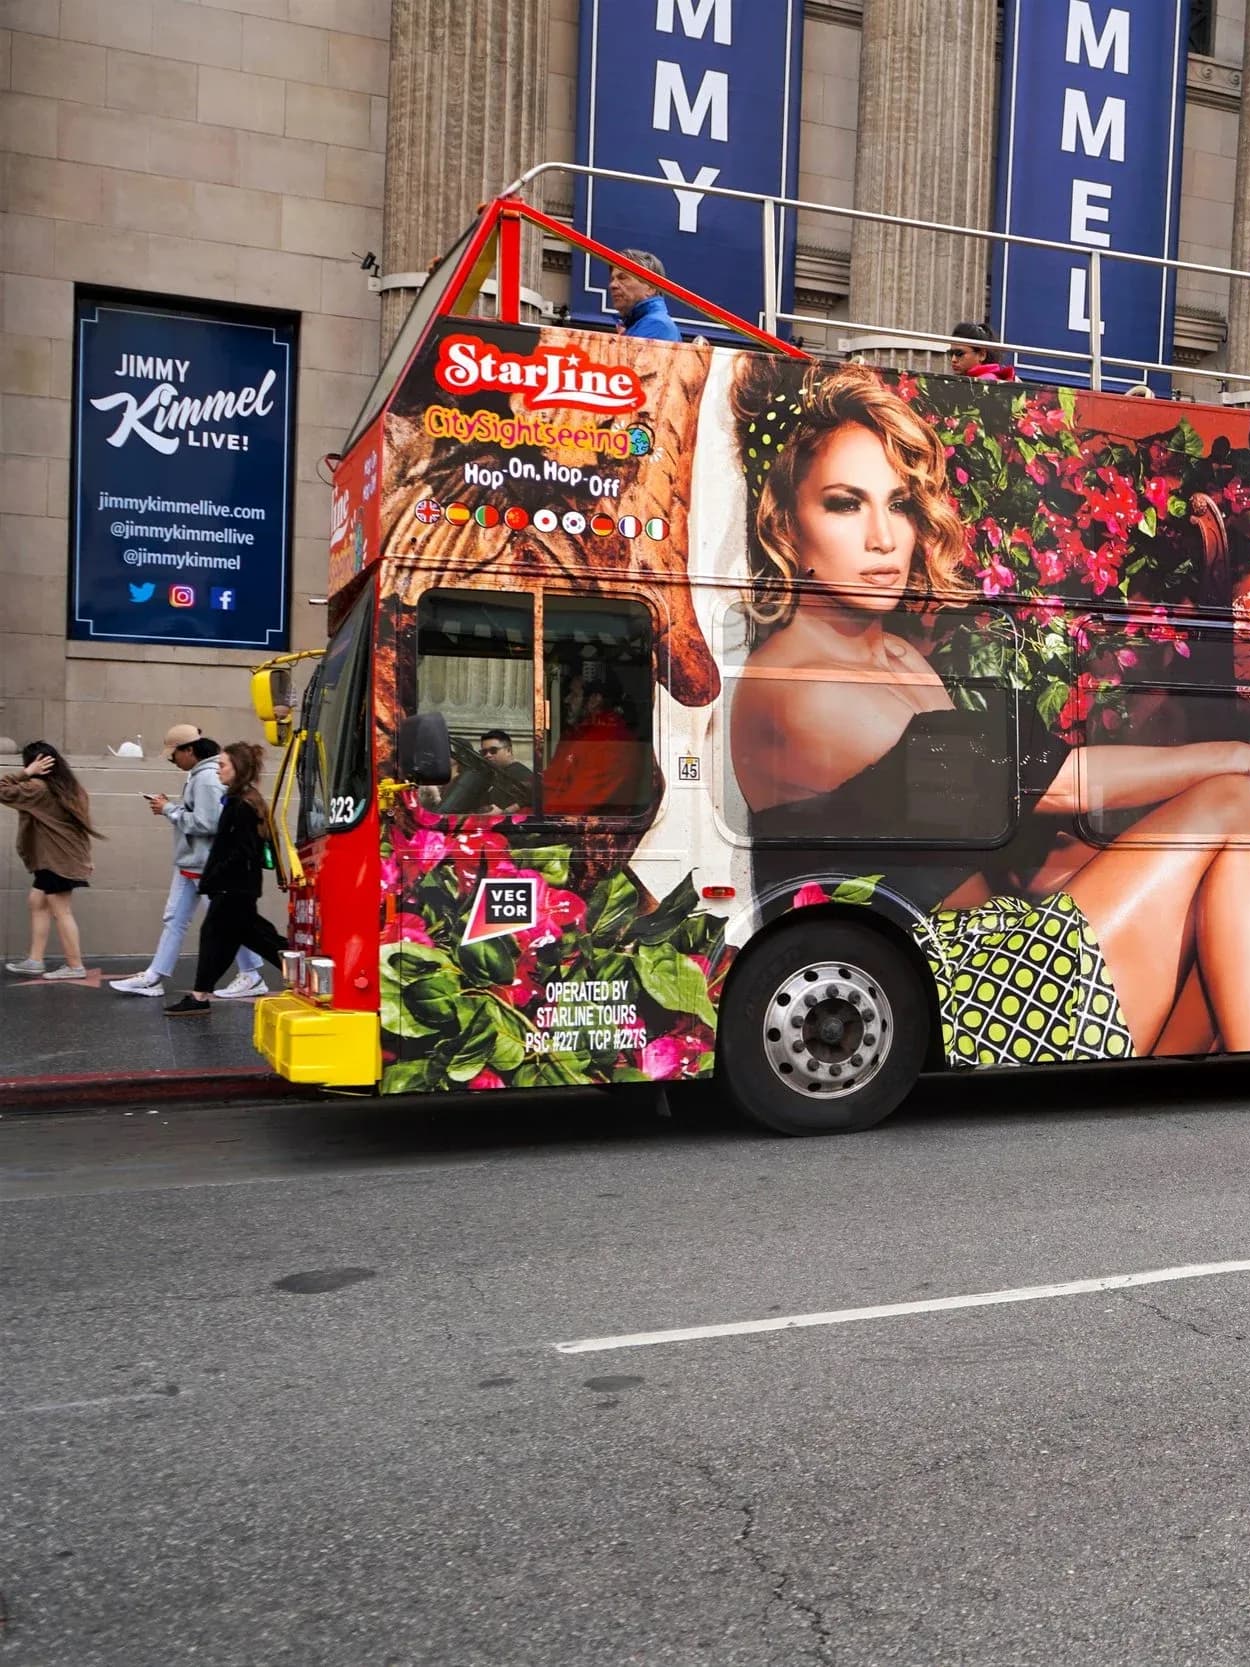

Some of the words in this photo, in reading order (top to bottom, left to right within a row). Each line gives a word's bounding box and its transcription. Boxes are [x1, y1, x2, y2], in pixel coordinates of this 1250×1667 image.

[1061, 0, 1130, 335] MMEL
[114, 353, 190, 383] JIMMY
[444, 343, 639, 408] StarLine
[90, 369, 277, 455] Kimmel
[188, 430, 249, 451] LIVE!
[426, 406, 630, 459] CitySightseeing
[98, 491, 266, 520] jimmykimmellive.com
[110, 520, 255, 545] @jimmykimmellive
[123, 548, 241, 570] @jimmykimmel
[681, 763, 698, 778] 45
[329, 796, 354, 825] 323
[491, 889, 527, 902] VEC
[491, 905, 528, 917] TOR
[545, 981, 609, 1003] OPERATED
[611, 980, 629, 1002] BY
[536, 1007, 594, 1028] STARLINE
[597, 1004, 637, 1025] TOURS
[525, 1032, 550, 1053] PSC
[552, 1031, 580, 1052] #227
[588, 1029, 612, 1050] TCP
